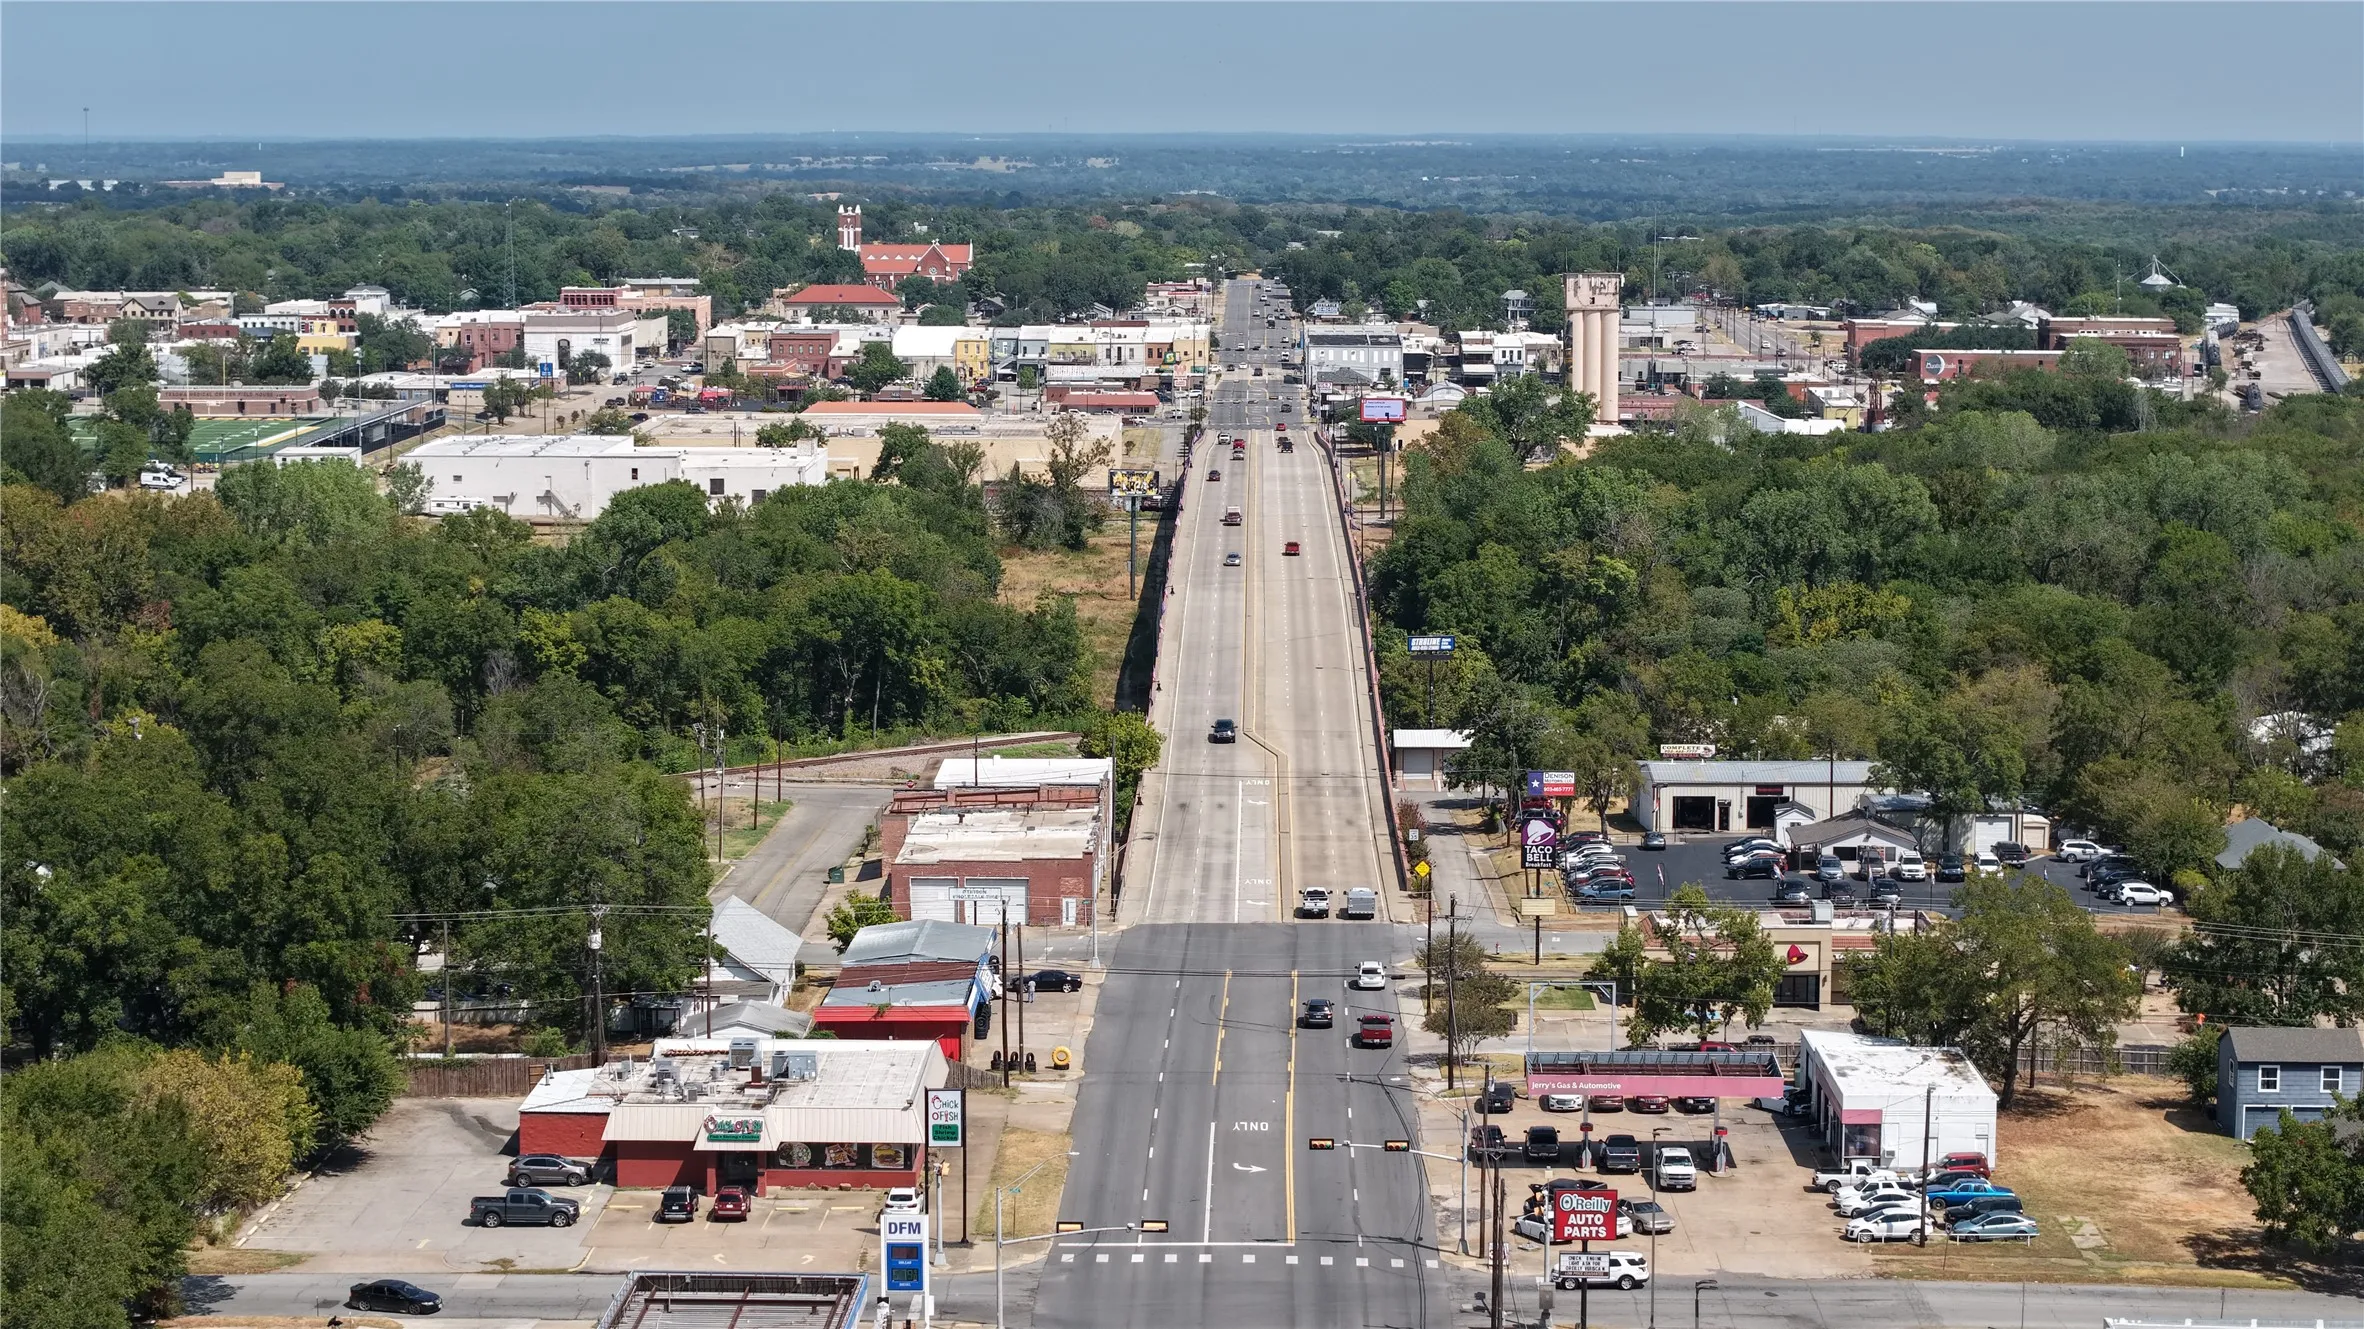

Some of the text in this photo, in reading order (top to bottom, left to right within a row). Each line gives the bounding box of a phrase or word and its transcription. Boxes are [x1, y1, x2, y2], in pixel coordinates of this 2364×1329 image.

[1525, 846, 1553, 854] TACO
[1233, 1121, 1269, 1131] ONLY
[1560, 1194, 1612, 1213] O'Reilly
[1567, 1214, 1604, 1225] AUTO
[888, 1222, 921, 1234] DFM
[1564, 1226, 1607, 1237] PARTS
